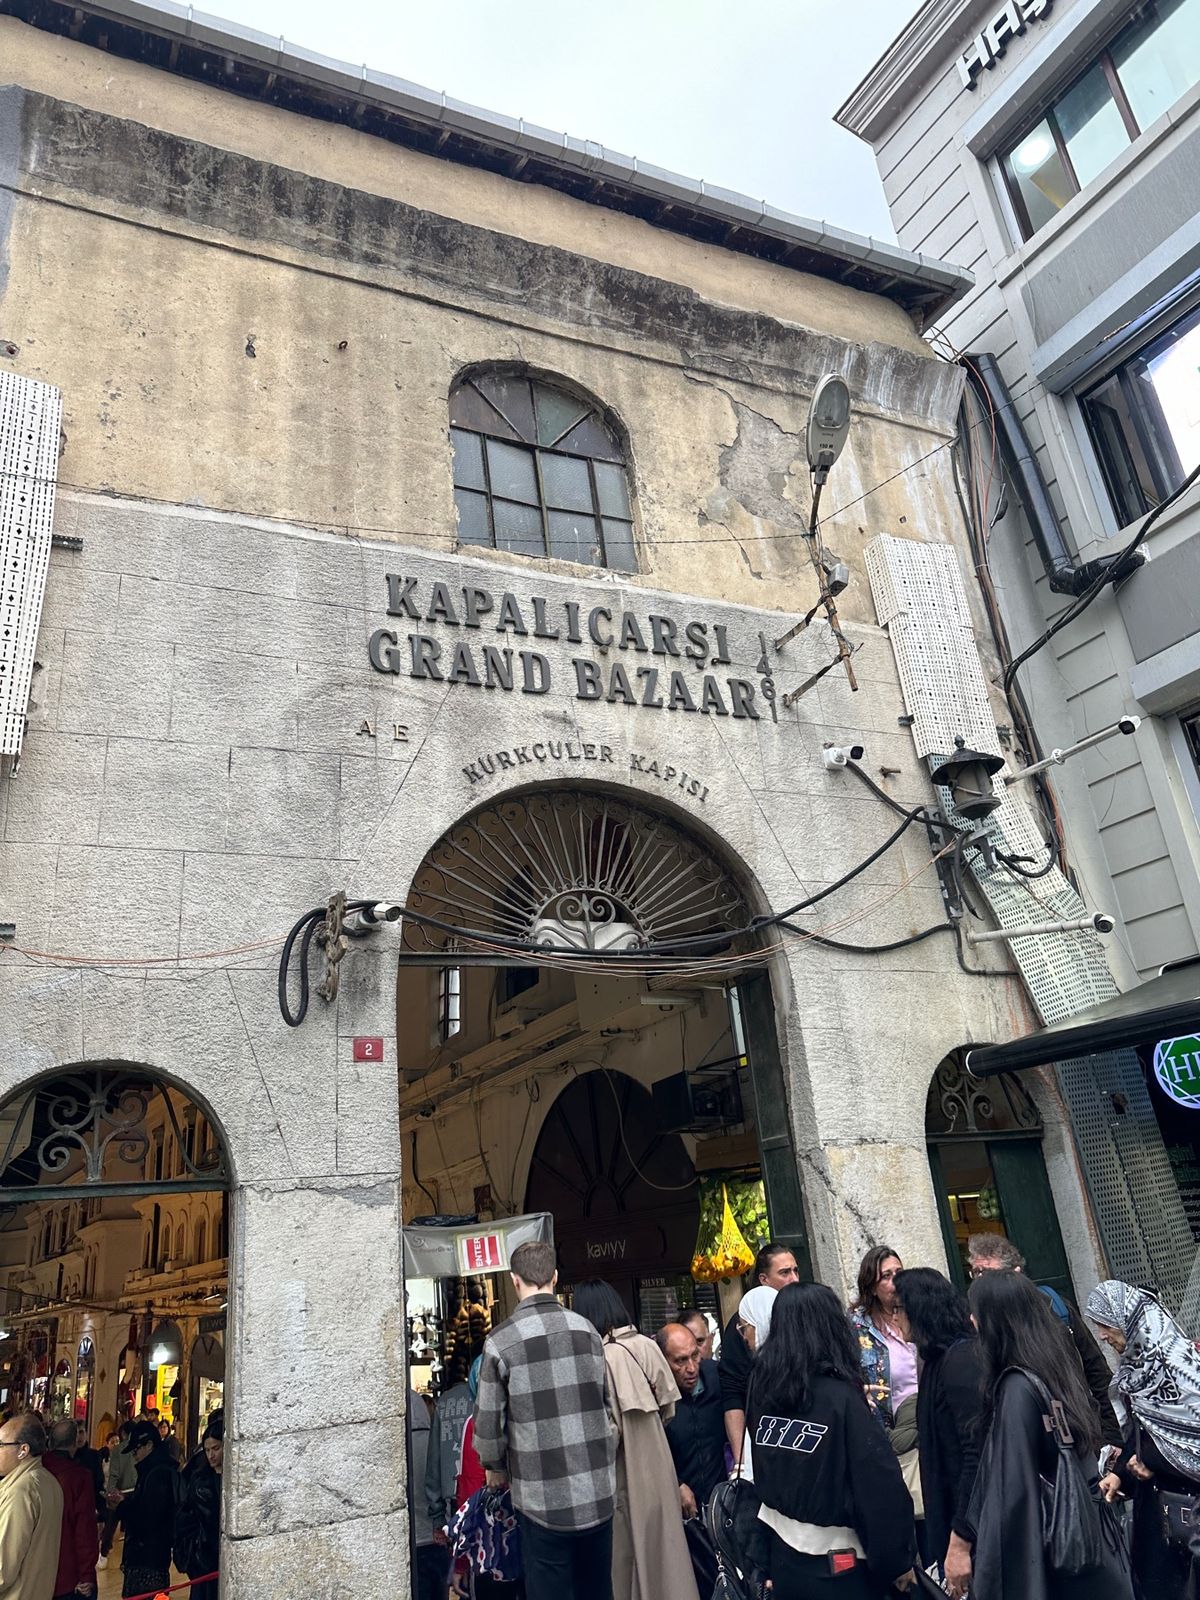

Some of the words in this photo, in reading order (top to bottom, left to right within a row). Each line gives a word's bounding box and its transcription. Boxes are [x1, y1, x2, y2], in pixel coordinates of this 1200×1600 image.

[385, 573, 732, 669] KAPALIÇARŞI
[369, 628, 551, 694] GRAND
[572, 658, 760, 720] BAZAAR
[630, 753, 710, 802] KAPISI
[365, 1043, 373, 1056] 2
[1167, 1051, 1200, 1083] H
[473, 1237, 484, 1268] ENTER
[755, 1415, 829, 1453] 86
